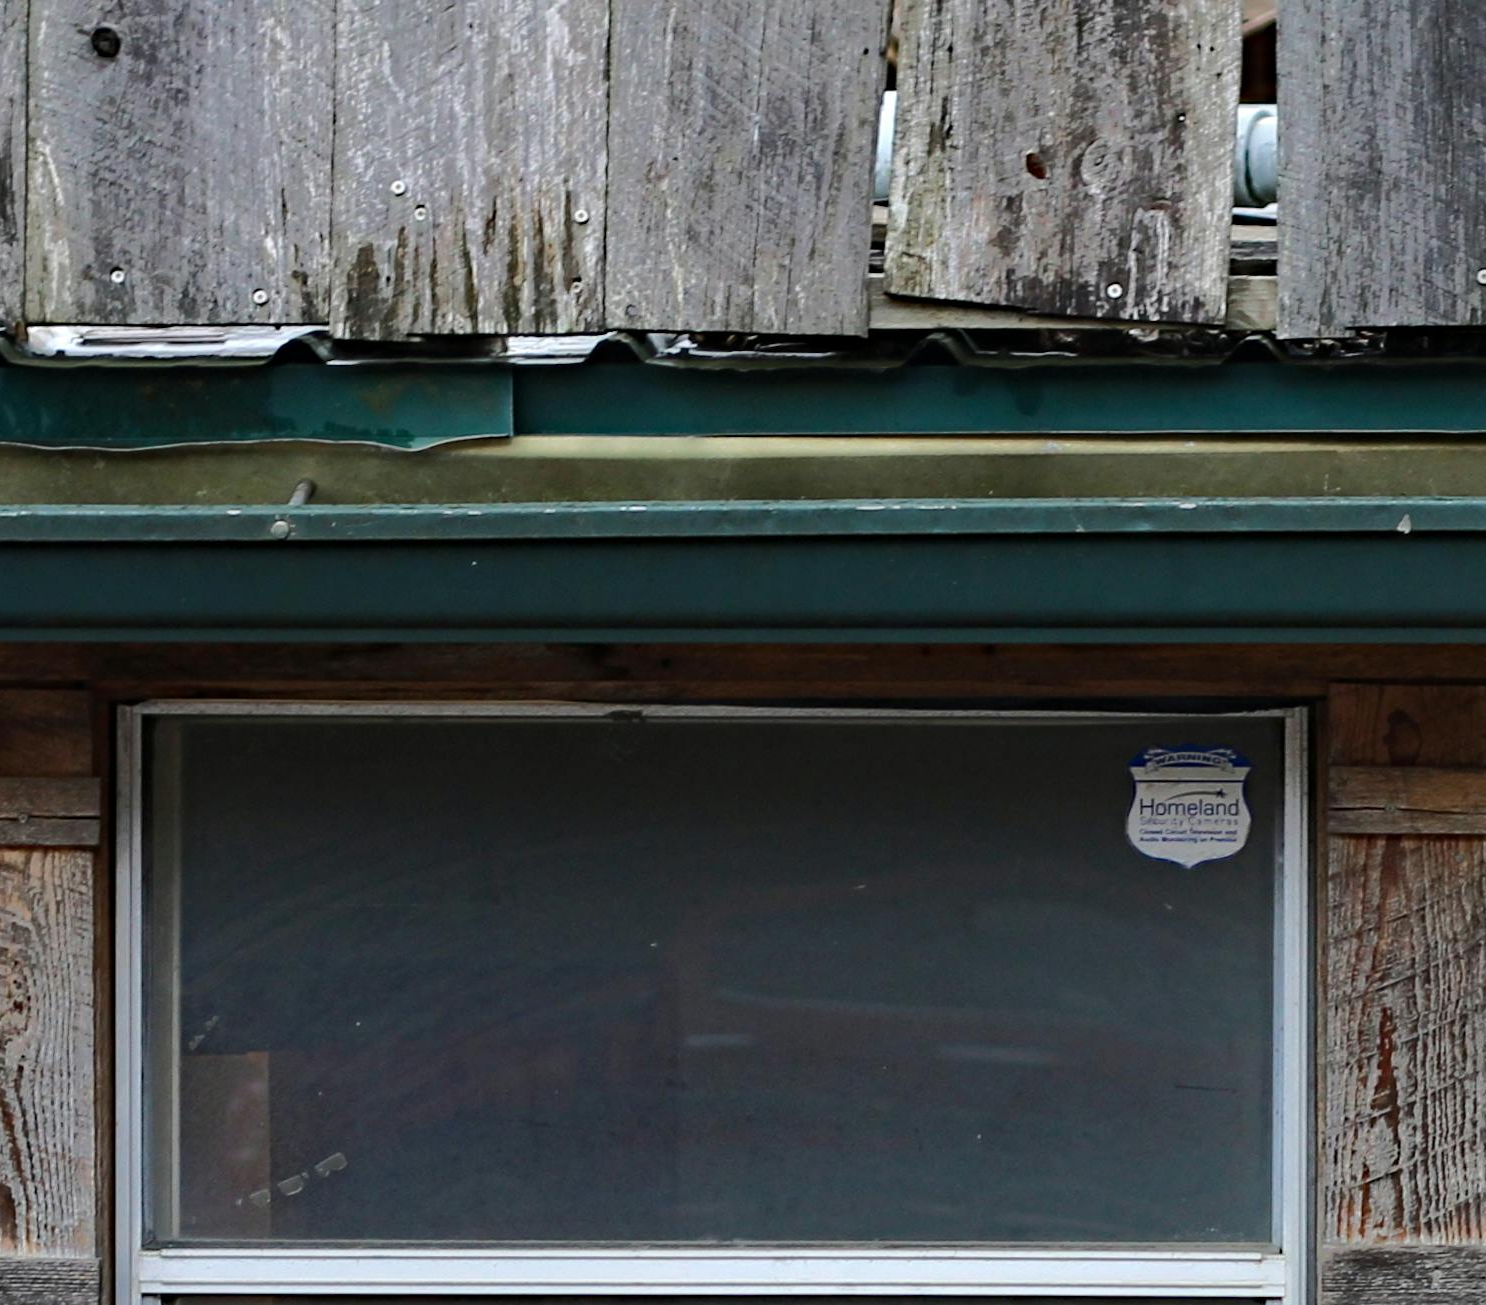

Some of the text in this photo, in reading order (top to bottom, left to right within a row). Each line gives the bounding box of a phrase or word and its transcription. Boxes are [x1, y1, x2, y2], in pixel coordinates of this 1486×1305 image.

[1139, 798, 1240, 817] Homeland
[1139, 816, 1239, 827] Security Cameras
